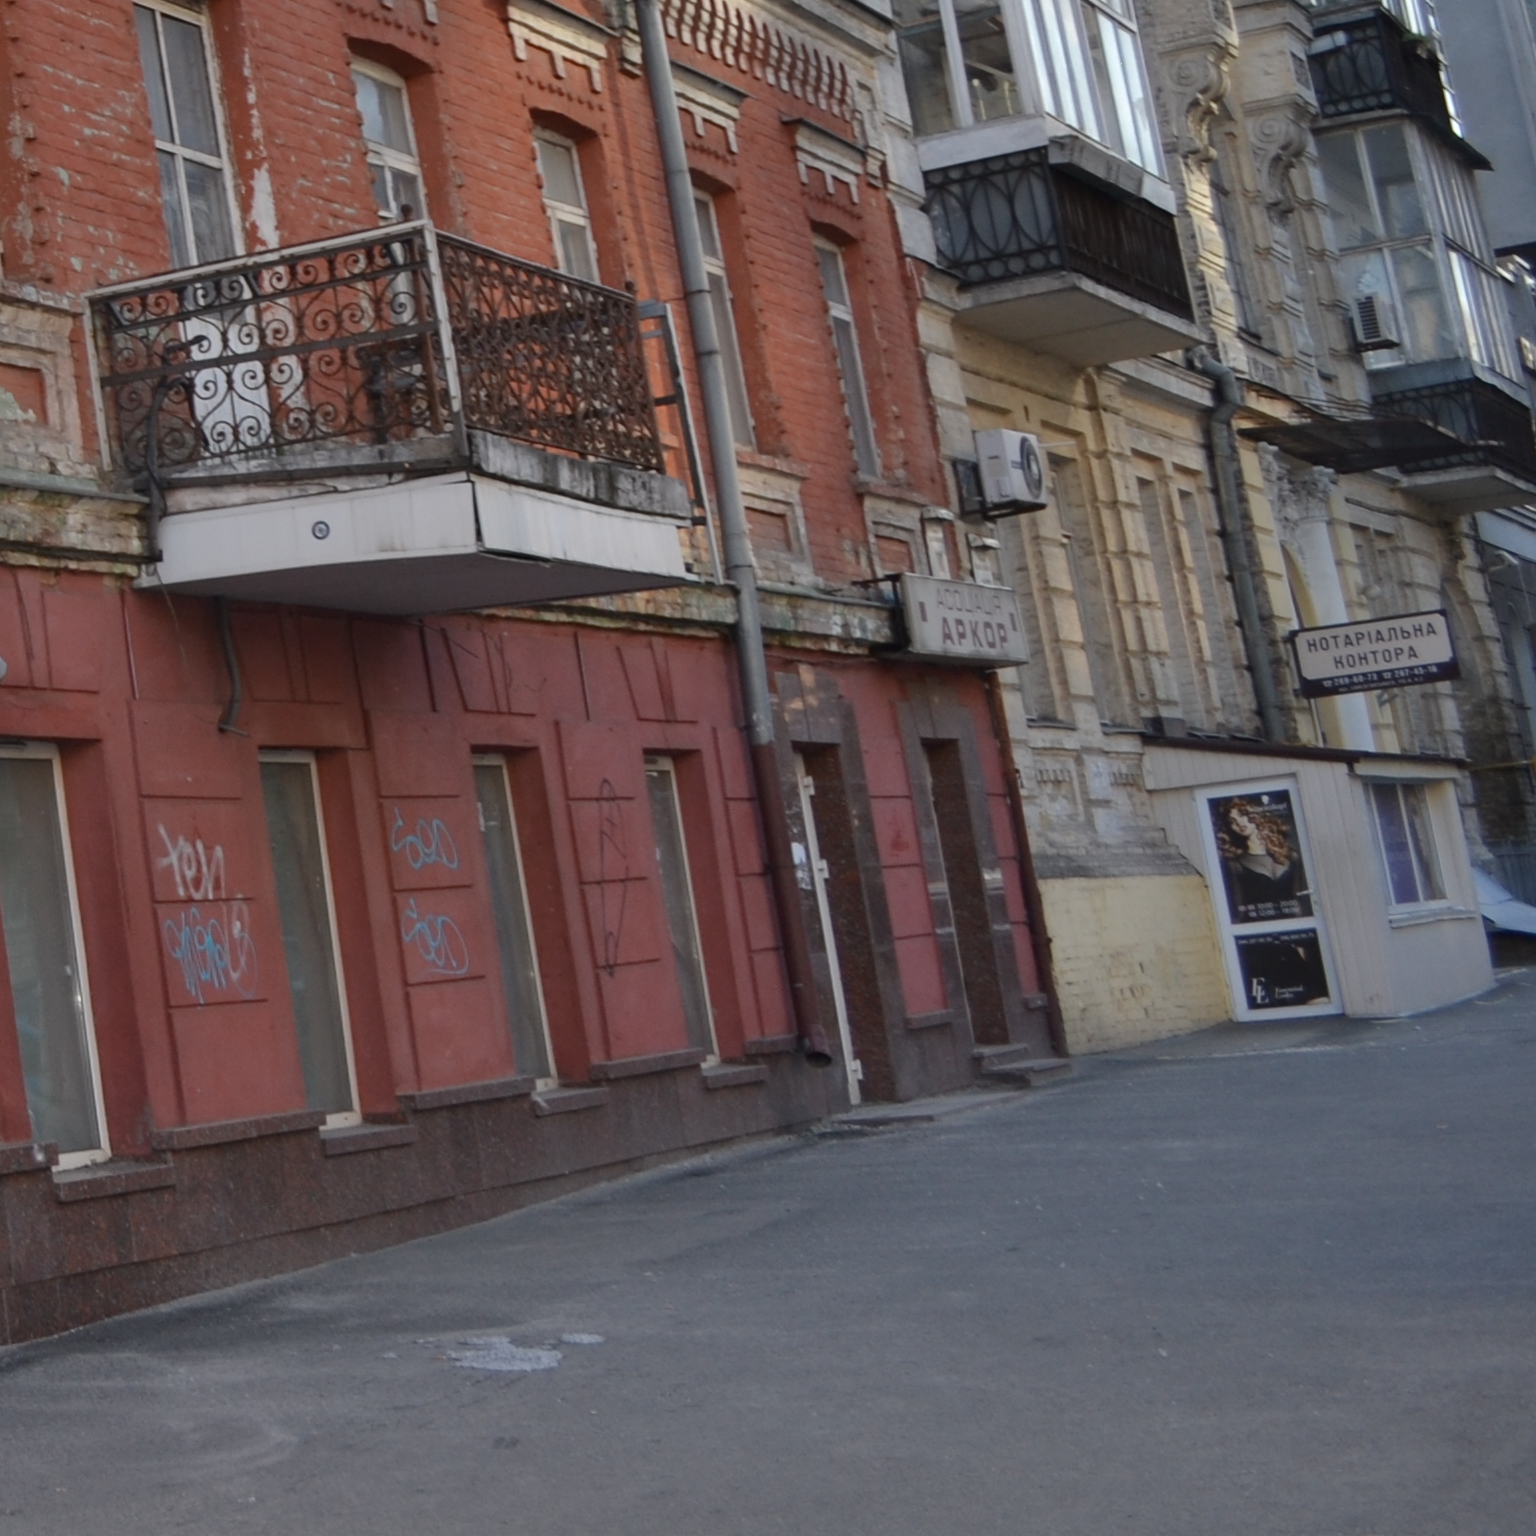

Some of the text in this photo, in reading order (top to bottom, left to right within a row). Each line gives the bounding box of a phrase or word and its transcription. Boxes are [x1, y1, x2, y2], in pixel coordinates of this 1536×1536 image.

[942, 616, 1008, 649] АРКОР
[1306, 622, 1437, 653] НОТАРІАЛЬНА
[1333, 645, 1419, 670] КОНТОРА
